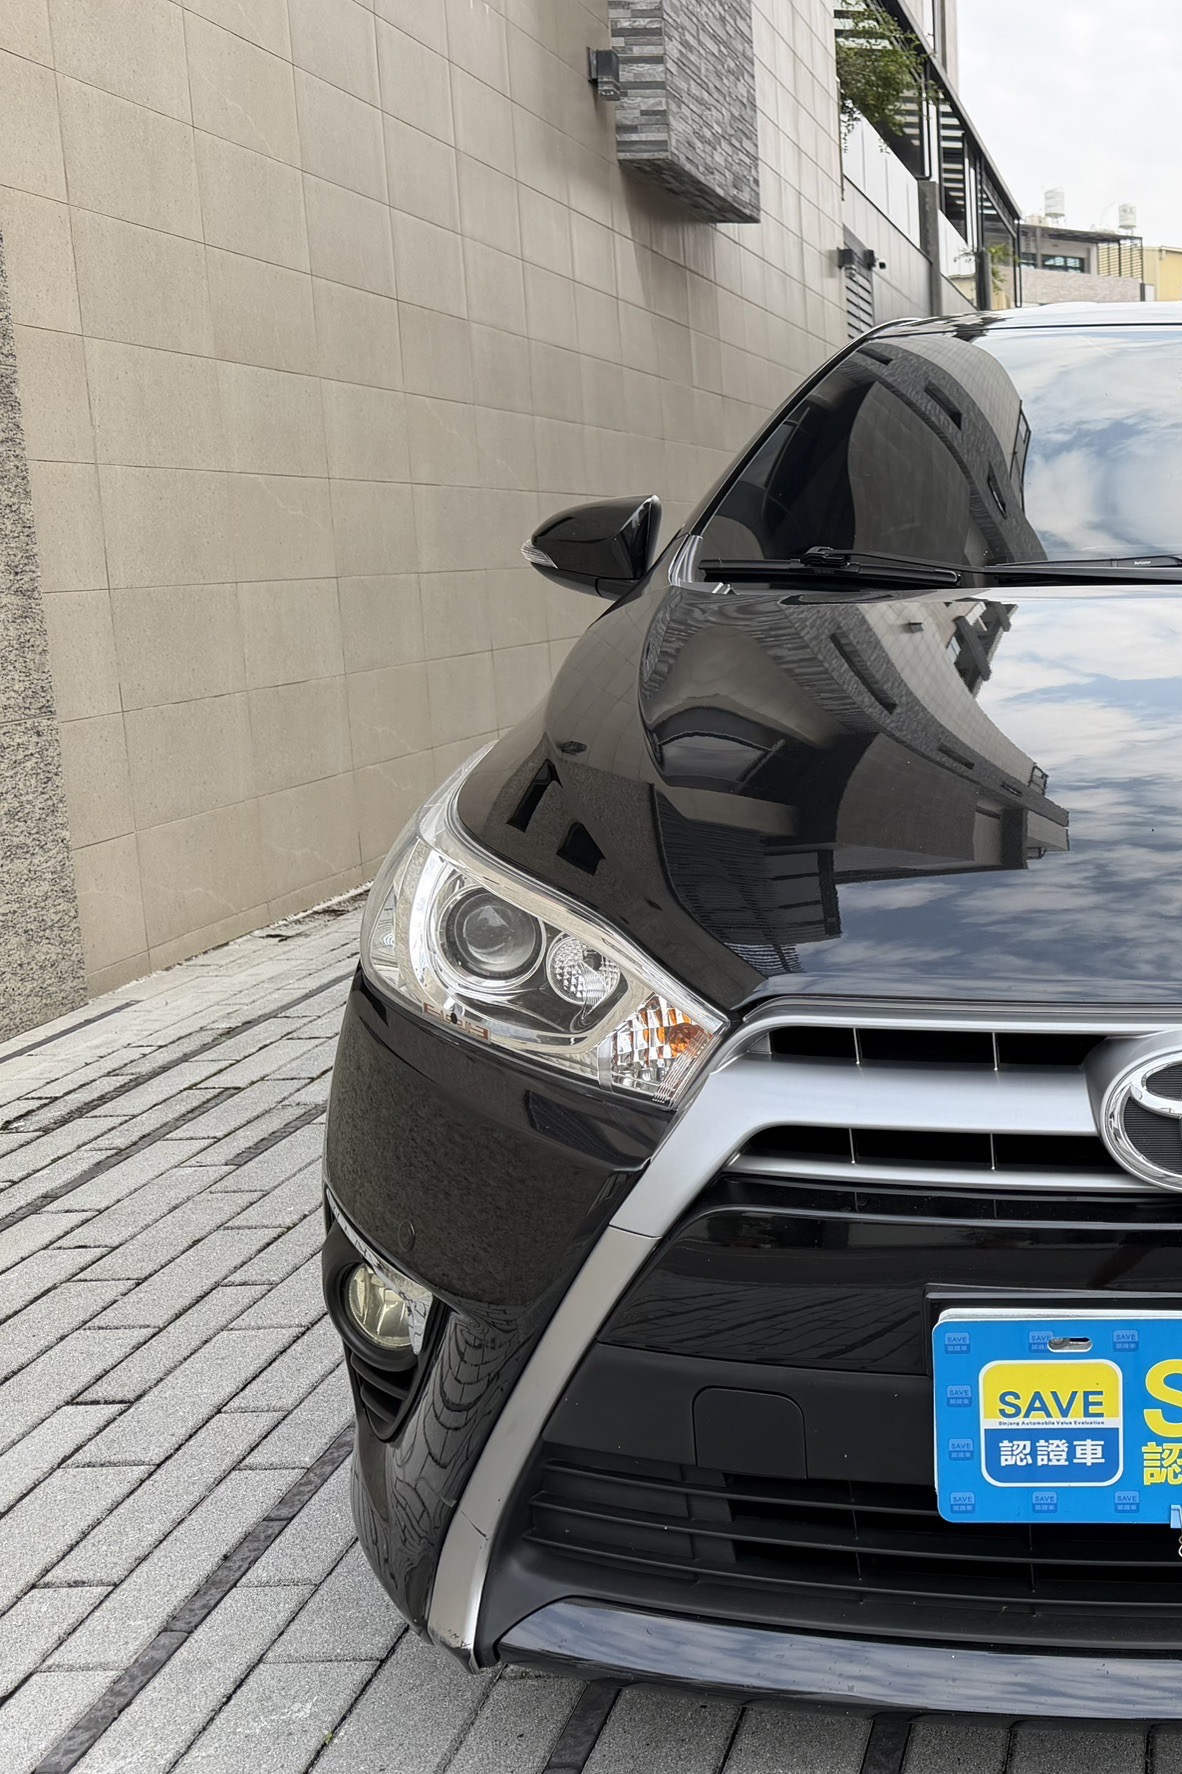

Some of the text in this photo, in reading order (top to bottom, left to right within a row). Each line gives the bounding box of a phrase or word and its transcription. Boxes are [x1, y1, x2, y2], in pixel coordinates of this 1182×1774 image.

[998, 1390, 1105, 1419] SAVE
[999, 1439, 1105, 1466] 認證車
